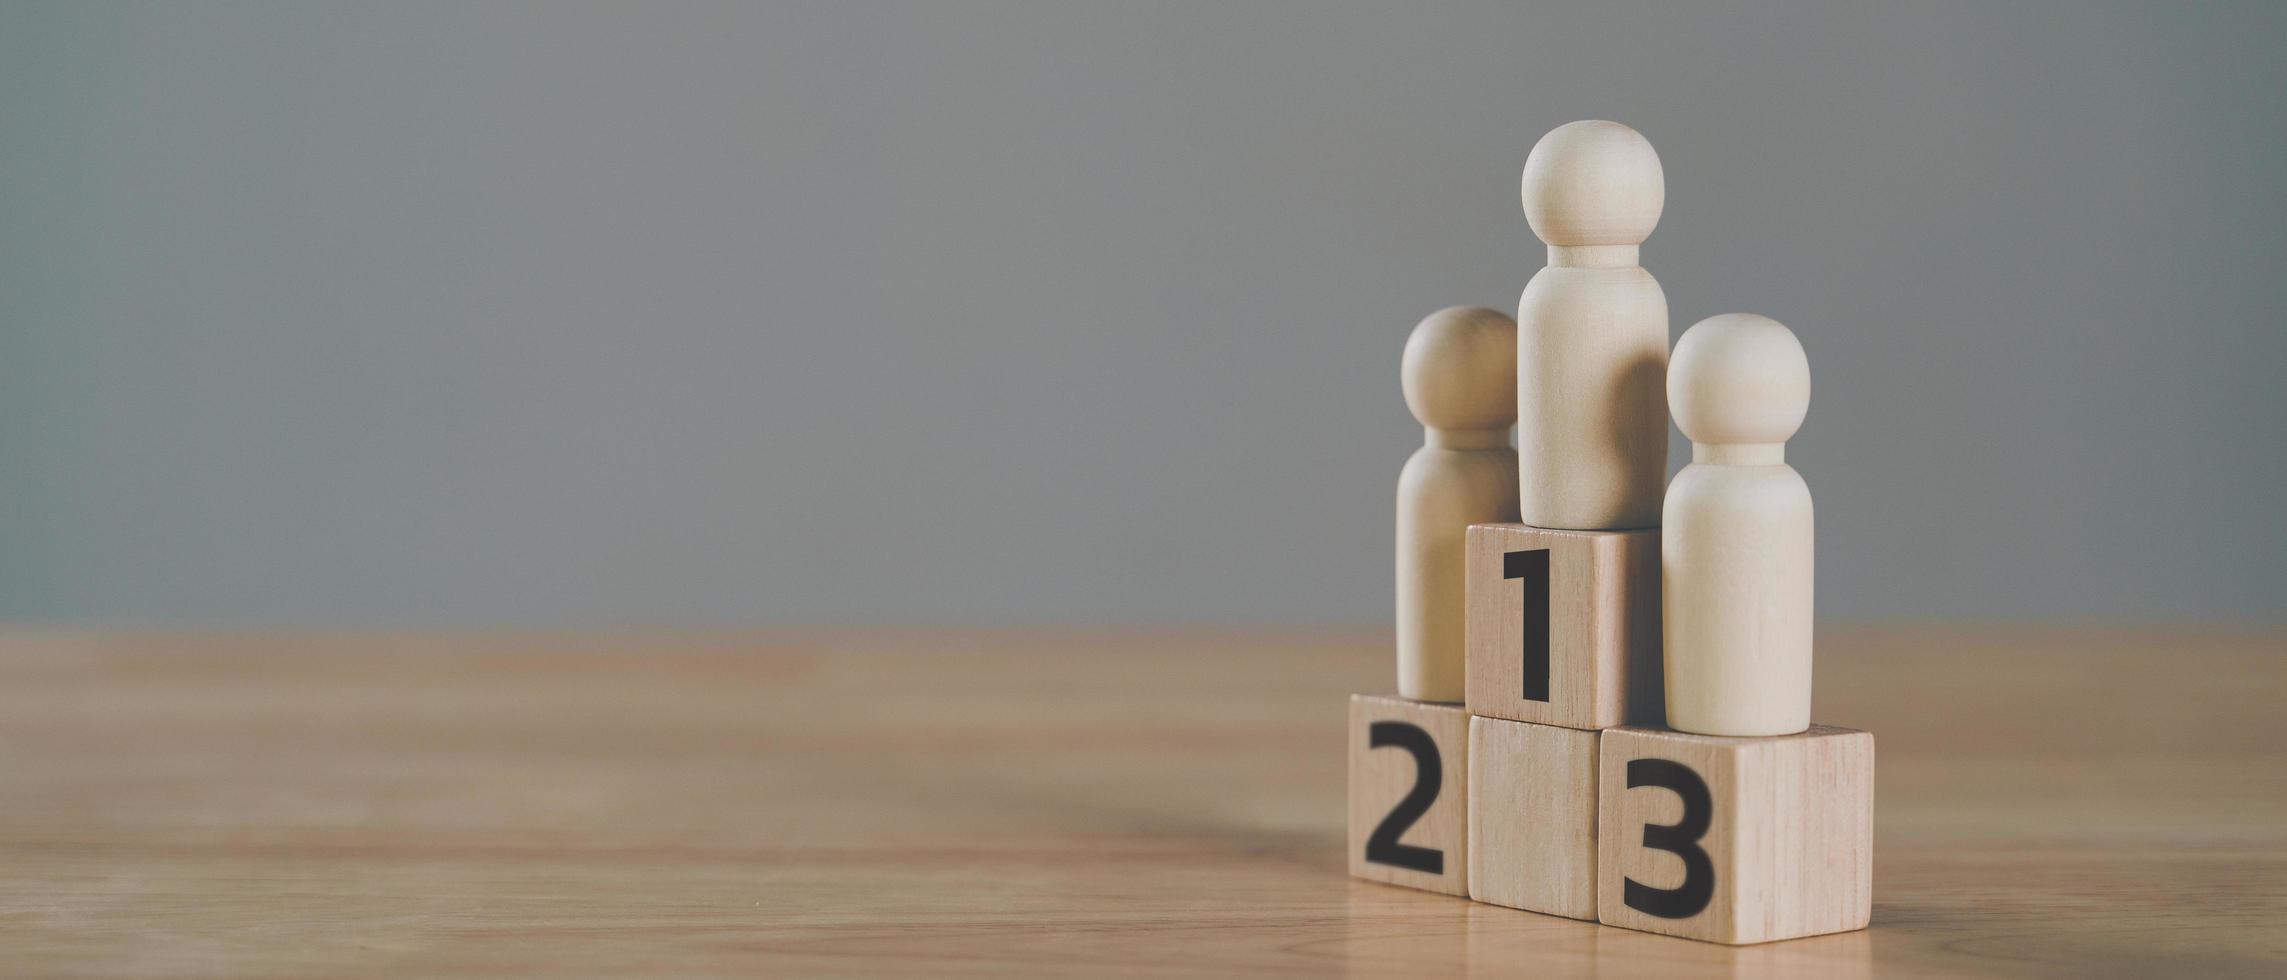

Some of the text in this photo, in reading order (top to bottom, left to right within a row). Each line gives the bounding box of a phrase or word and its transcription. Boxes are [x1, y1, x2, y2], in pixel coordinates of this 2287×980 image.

[1503, 548, 1550, 703] 1
[1365, 720, 1444, 876] 2
[1623, 758, 1716, 920] 3
